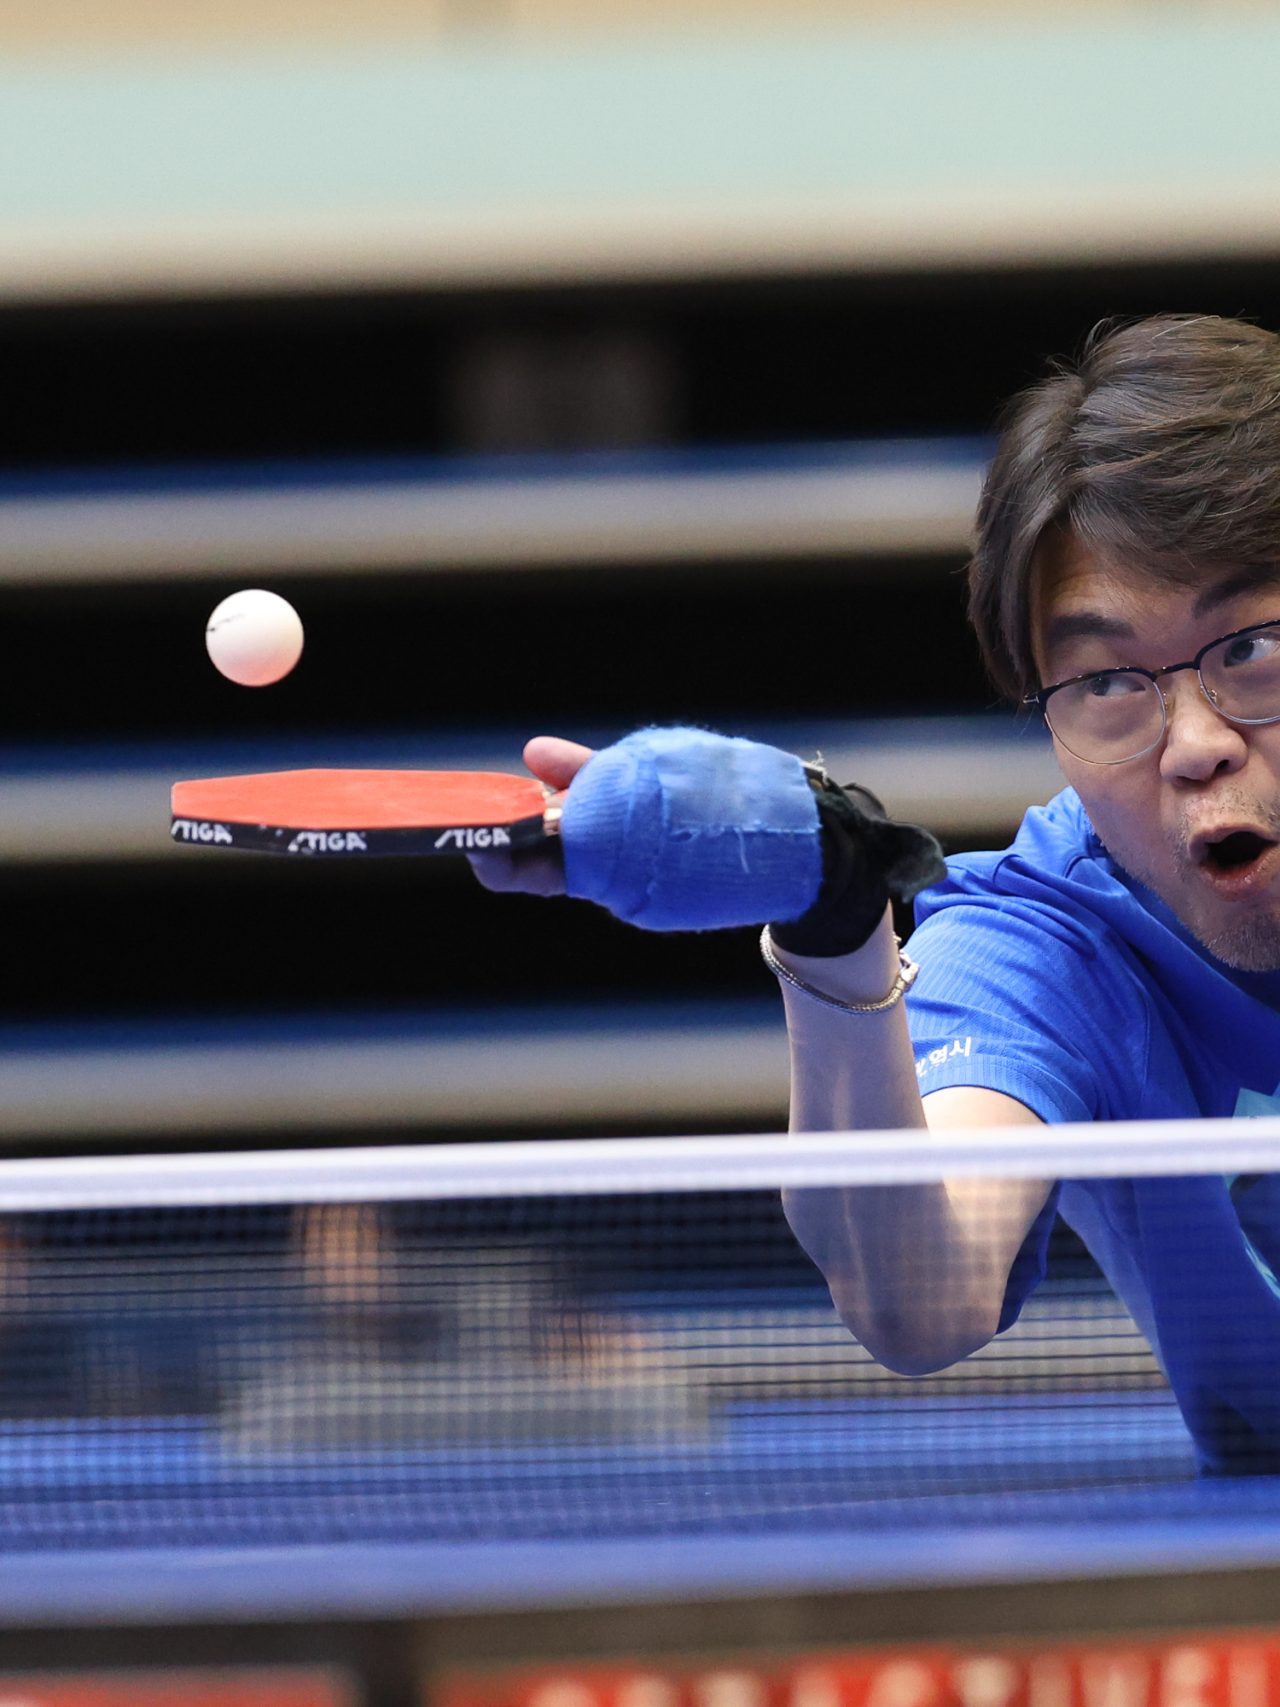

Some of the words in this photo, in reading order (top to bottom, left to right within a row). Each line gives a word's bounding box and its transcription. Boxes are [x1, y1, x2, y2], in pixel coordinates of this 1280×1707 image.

[171, 819, 233, 844] STIGA
[288, 830, 368, 853] STIGA
[434, 826, 512, 849] STIGA
